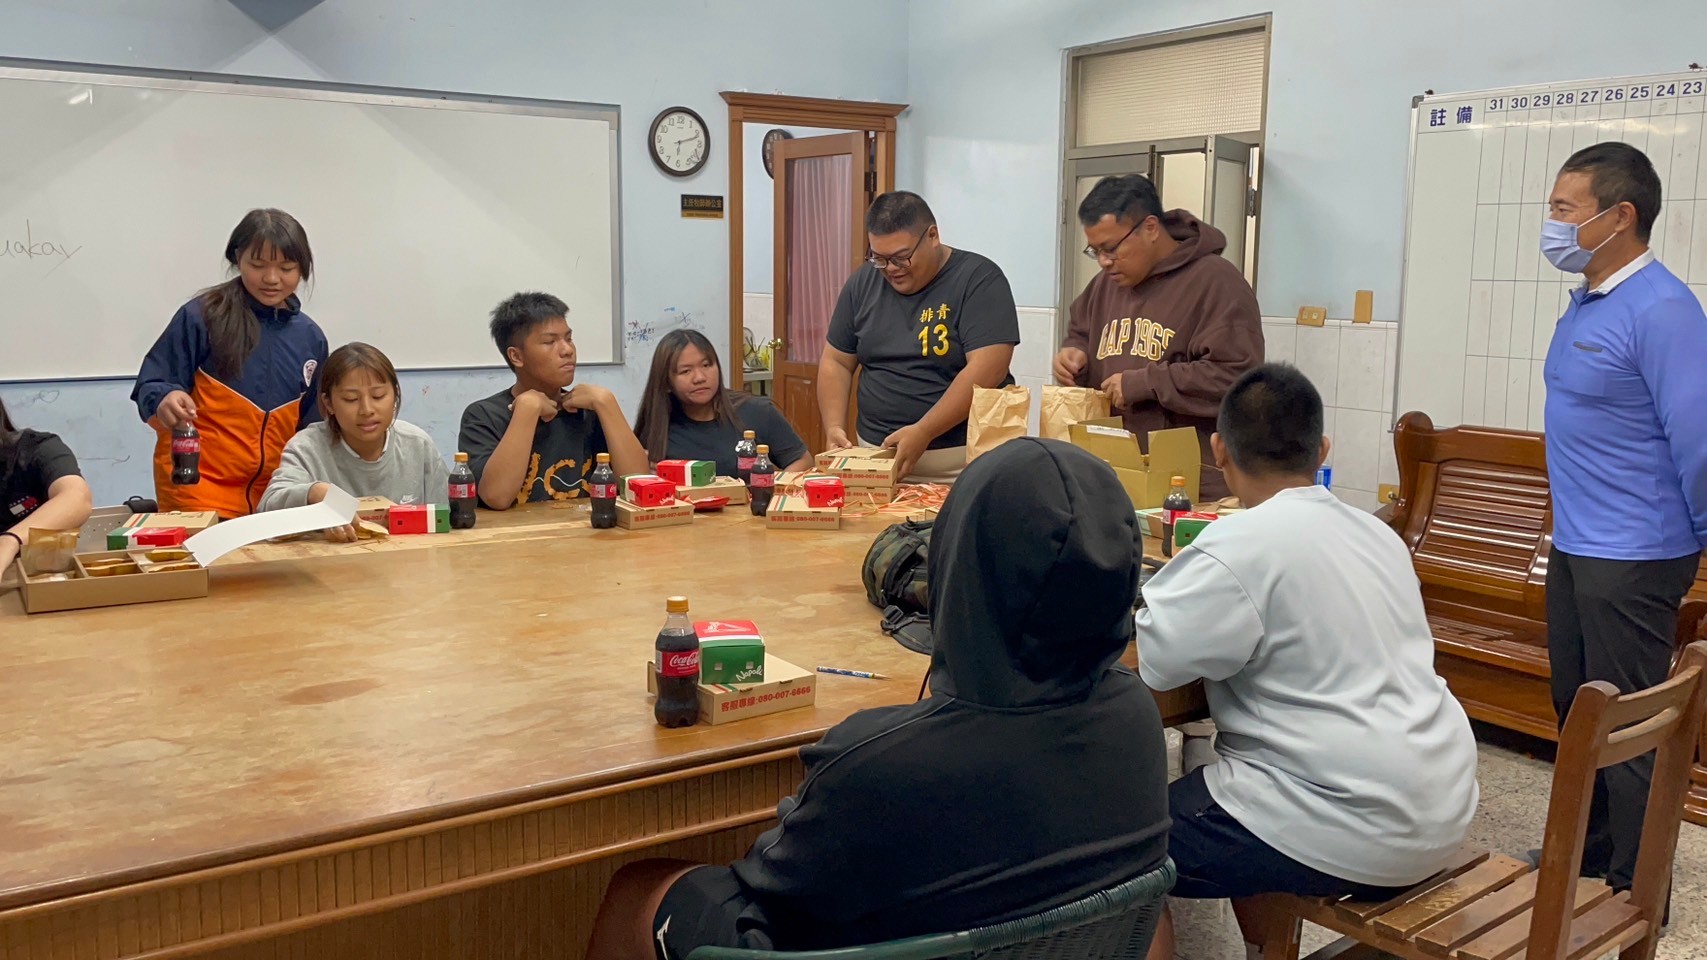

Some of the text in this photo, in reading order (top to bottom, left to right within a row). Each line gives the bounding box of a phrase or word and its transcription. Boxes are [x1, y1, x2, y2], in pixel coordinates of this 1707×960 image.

[1489, 81, 1703, 110] 31 30 29 28 27 26 25 24 23
[918, 323, 950, 357] 13
[735, 664, 764, 682] Napoli
